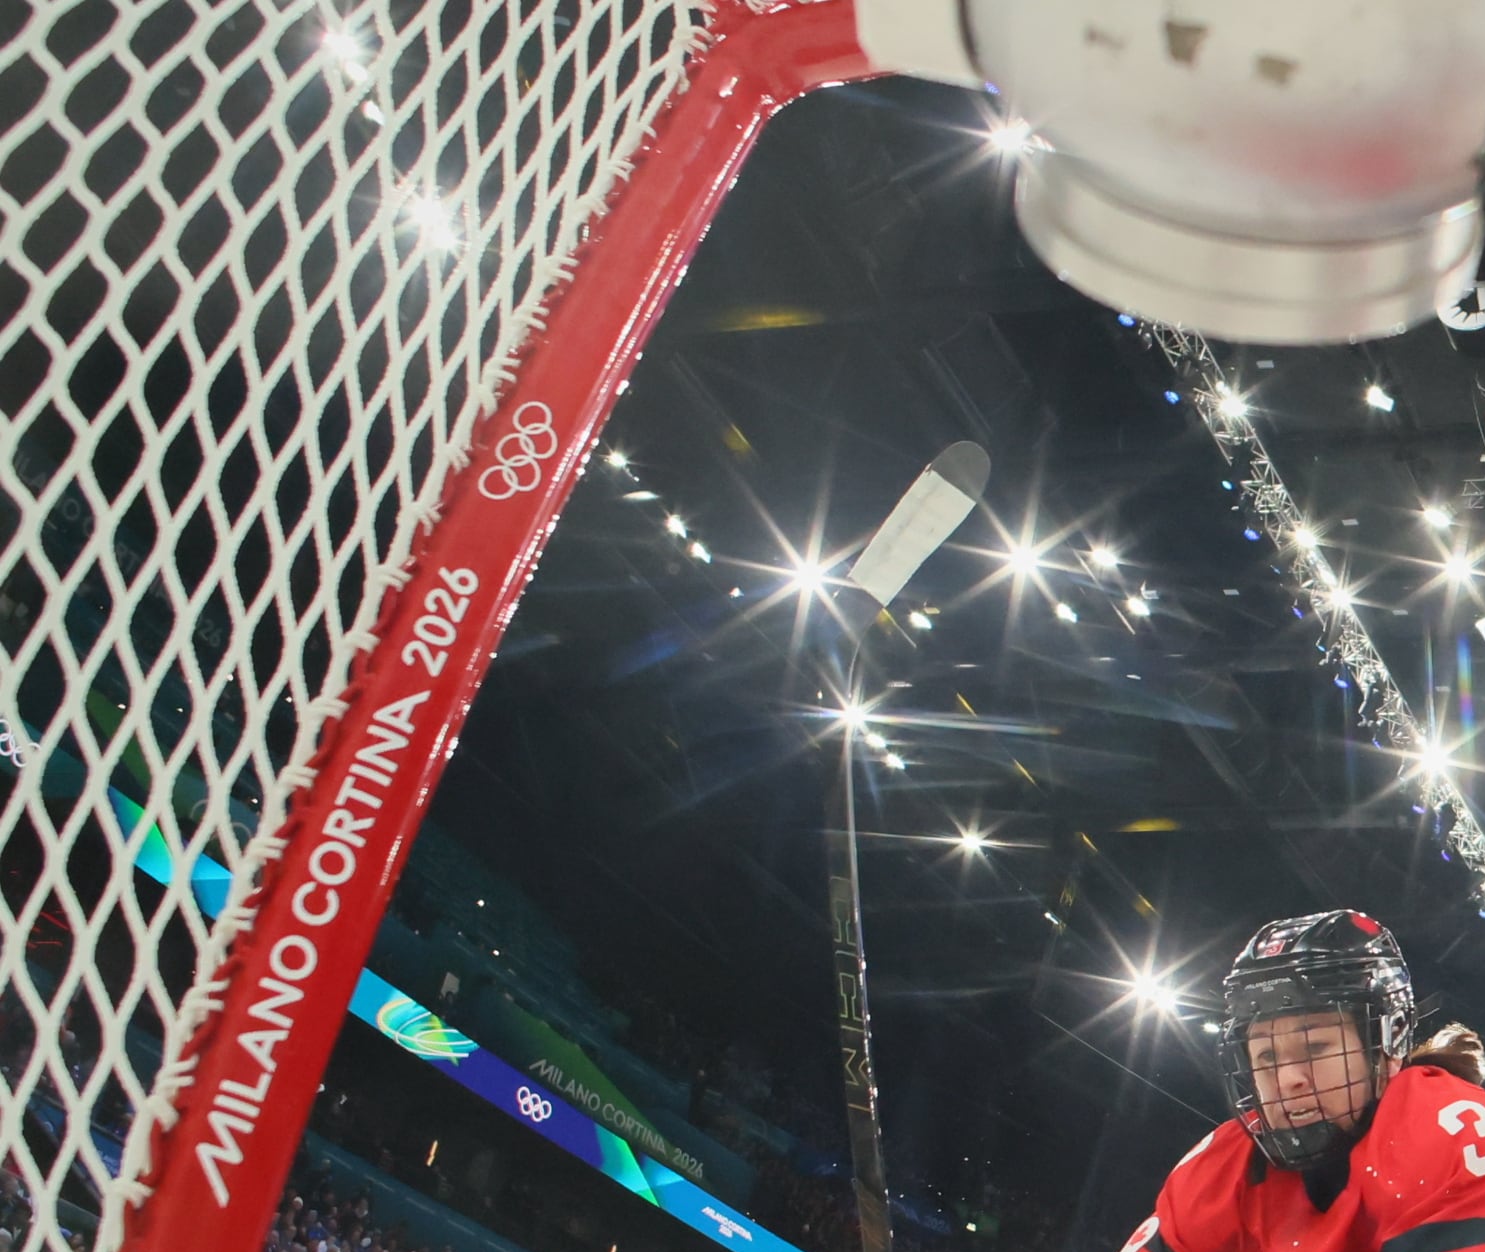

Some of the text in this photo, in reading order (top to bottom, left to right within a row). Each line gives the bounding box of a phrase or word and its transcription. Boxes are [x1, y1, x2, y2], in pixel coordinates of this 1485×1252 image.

[196, 566, 479, 1208] MILANO CORTINA 2026
[528, 1058, 704, 1179] MILANO CORTINA 2026
